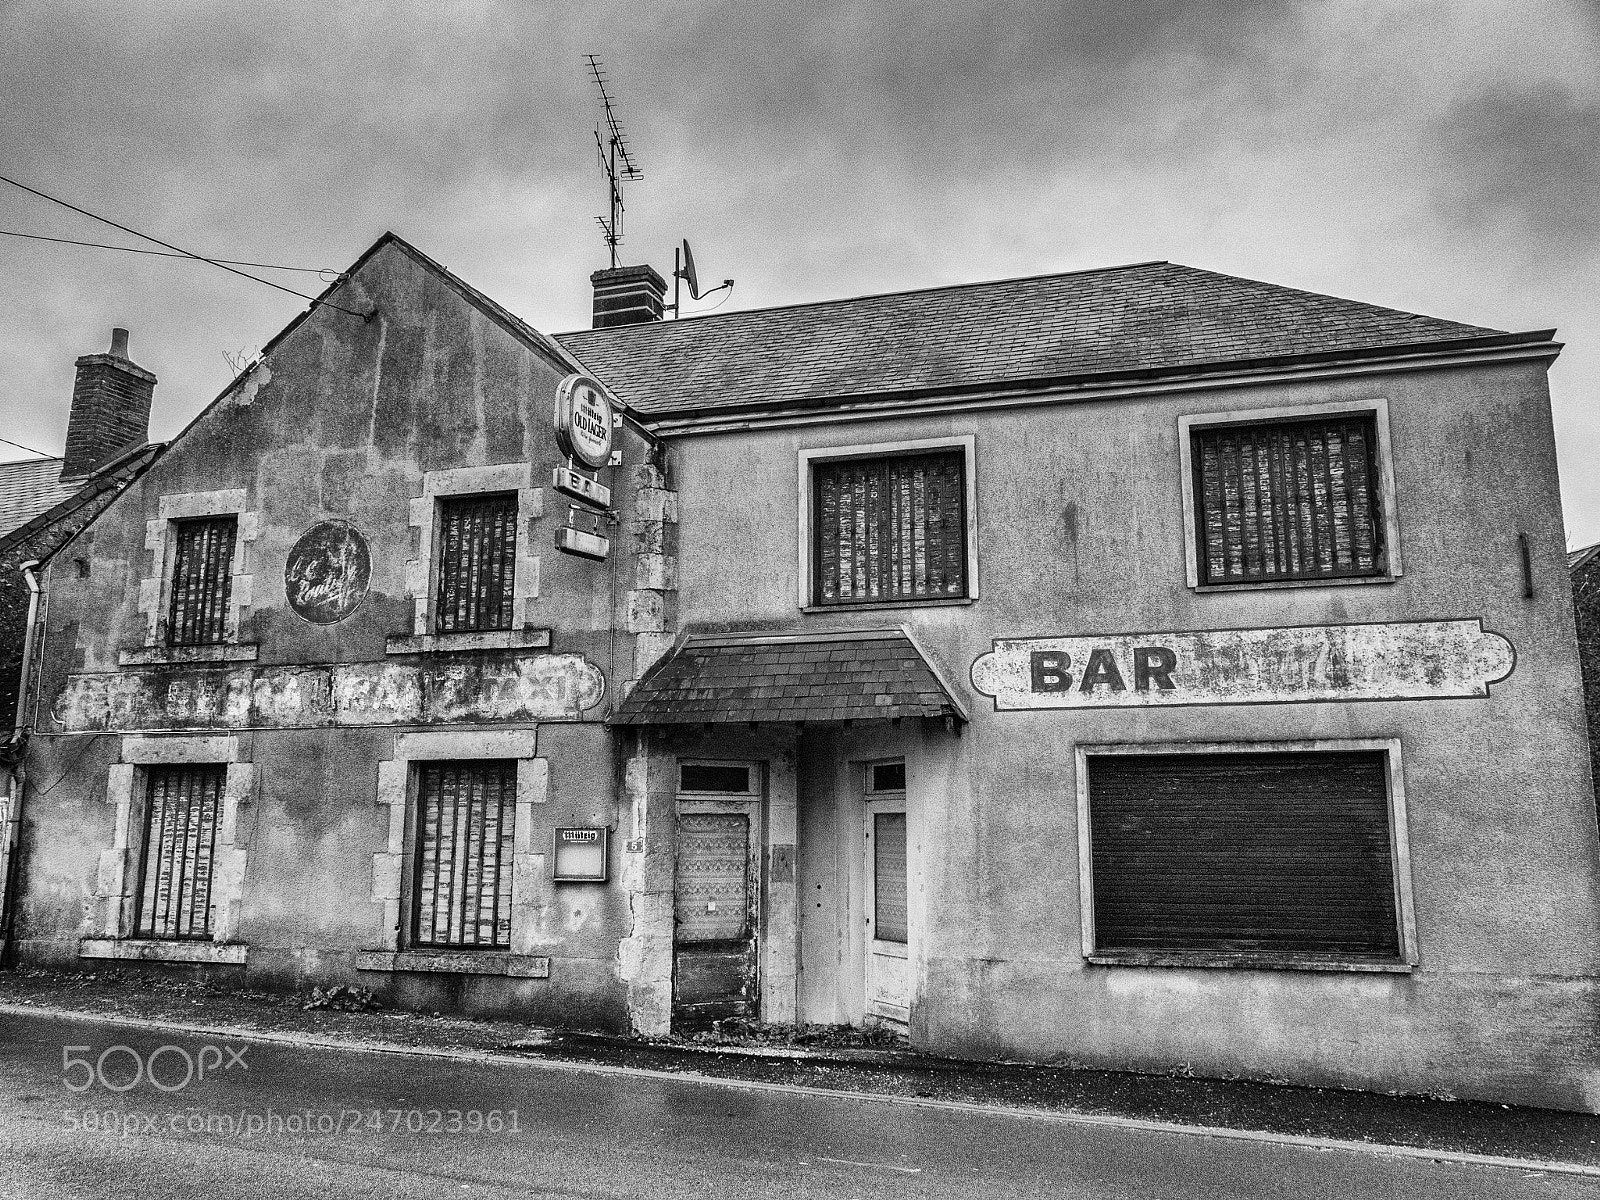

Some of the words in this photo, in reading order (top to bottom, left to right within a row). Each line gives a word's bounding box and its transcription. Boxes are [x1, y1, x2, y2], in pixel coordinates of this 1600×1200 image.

[574, 411, 588, 431] OLD
[588, 418, 607, 441] LAGER
[1030, 646, 1178, 694] BAR
[631, 842, 638, 850] 5
